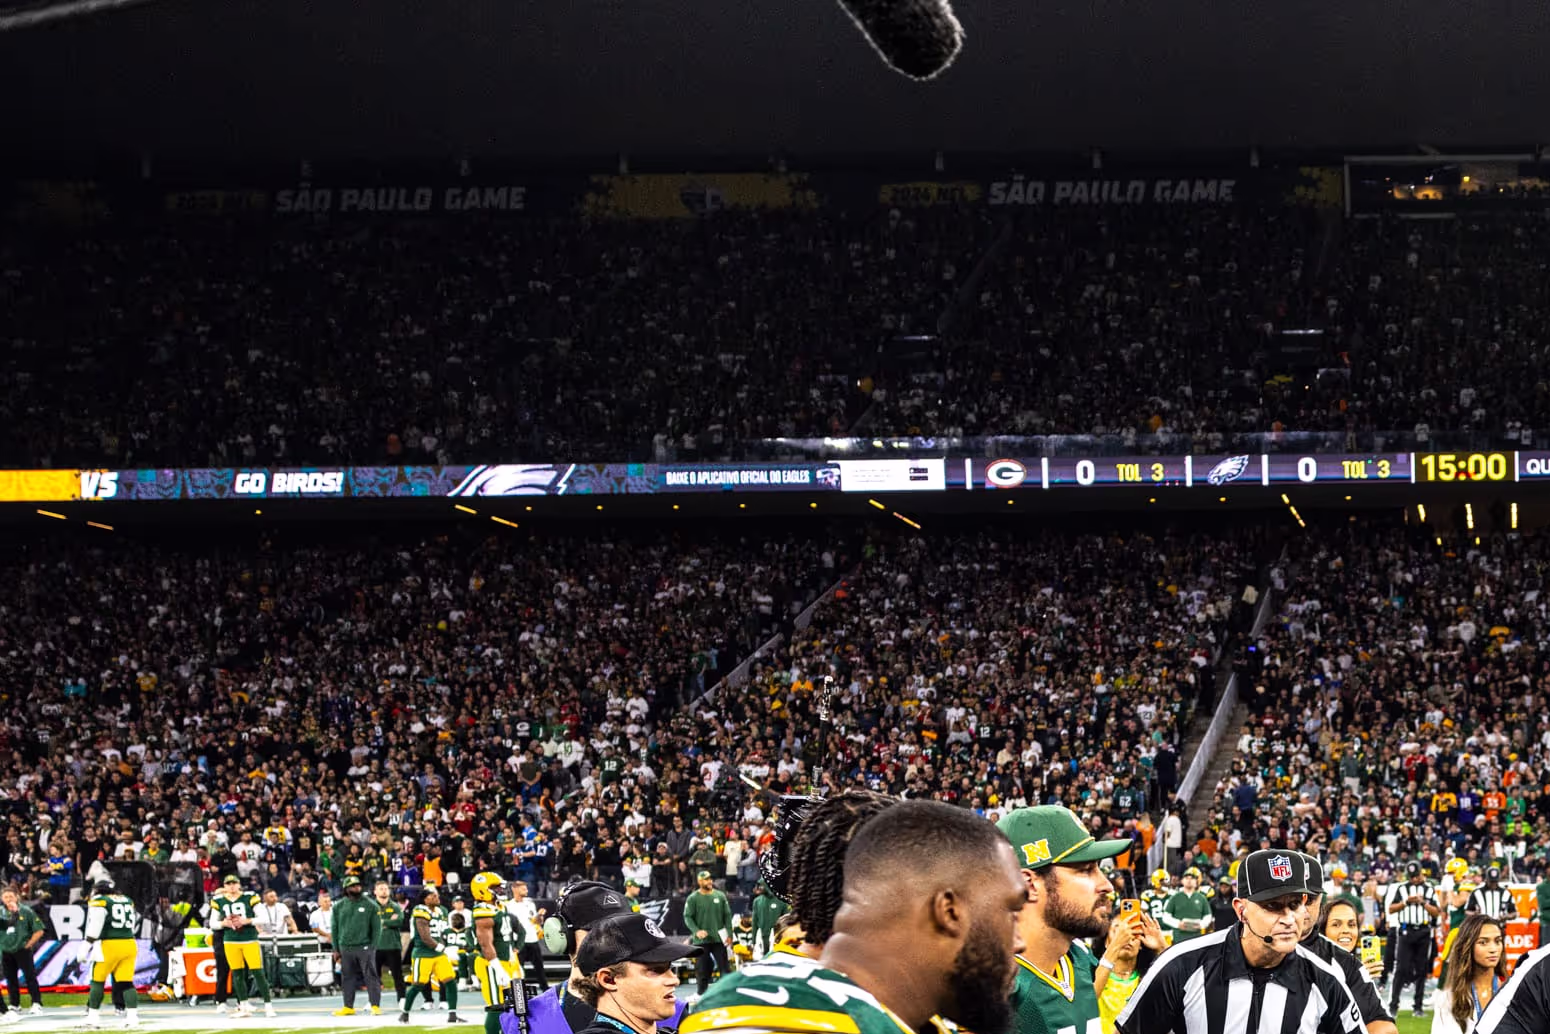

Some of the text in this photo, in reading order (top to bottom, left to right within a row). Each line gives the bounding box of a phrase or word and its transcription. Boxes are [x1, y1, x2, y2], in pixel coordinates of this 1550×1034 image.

[274, 181, 331, 212] SÃO
[339, 187, 433, 211] PAULO
[444, 186, 527, 210] GAME
[988, 173, 1046, 204] SÃO
[1054, 179, 1146, 204] PAULO
[1152, 179, 1237, 204] GAME
[666, 470, 690, 485] BAIXE
[697, 470, 740, 485] APLICATIVO
[741, 469, 768, 485] OFICIAL
[783, 469, 811, 484] EAGLES
[1076, 460, 1165, 485] 0 TOL 3
[1297, 457, 1391, 482] 0 TOL 3
[1422, 454, 1506, 481] 15:00
[80, 471, 118, 498] VS
[235, 472, 344, 494] GO BIRDS!
[112, 903, 135, 928] 93
